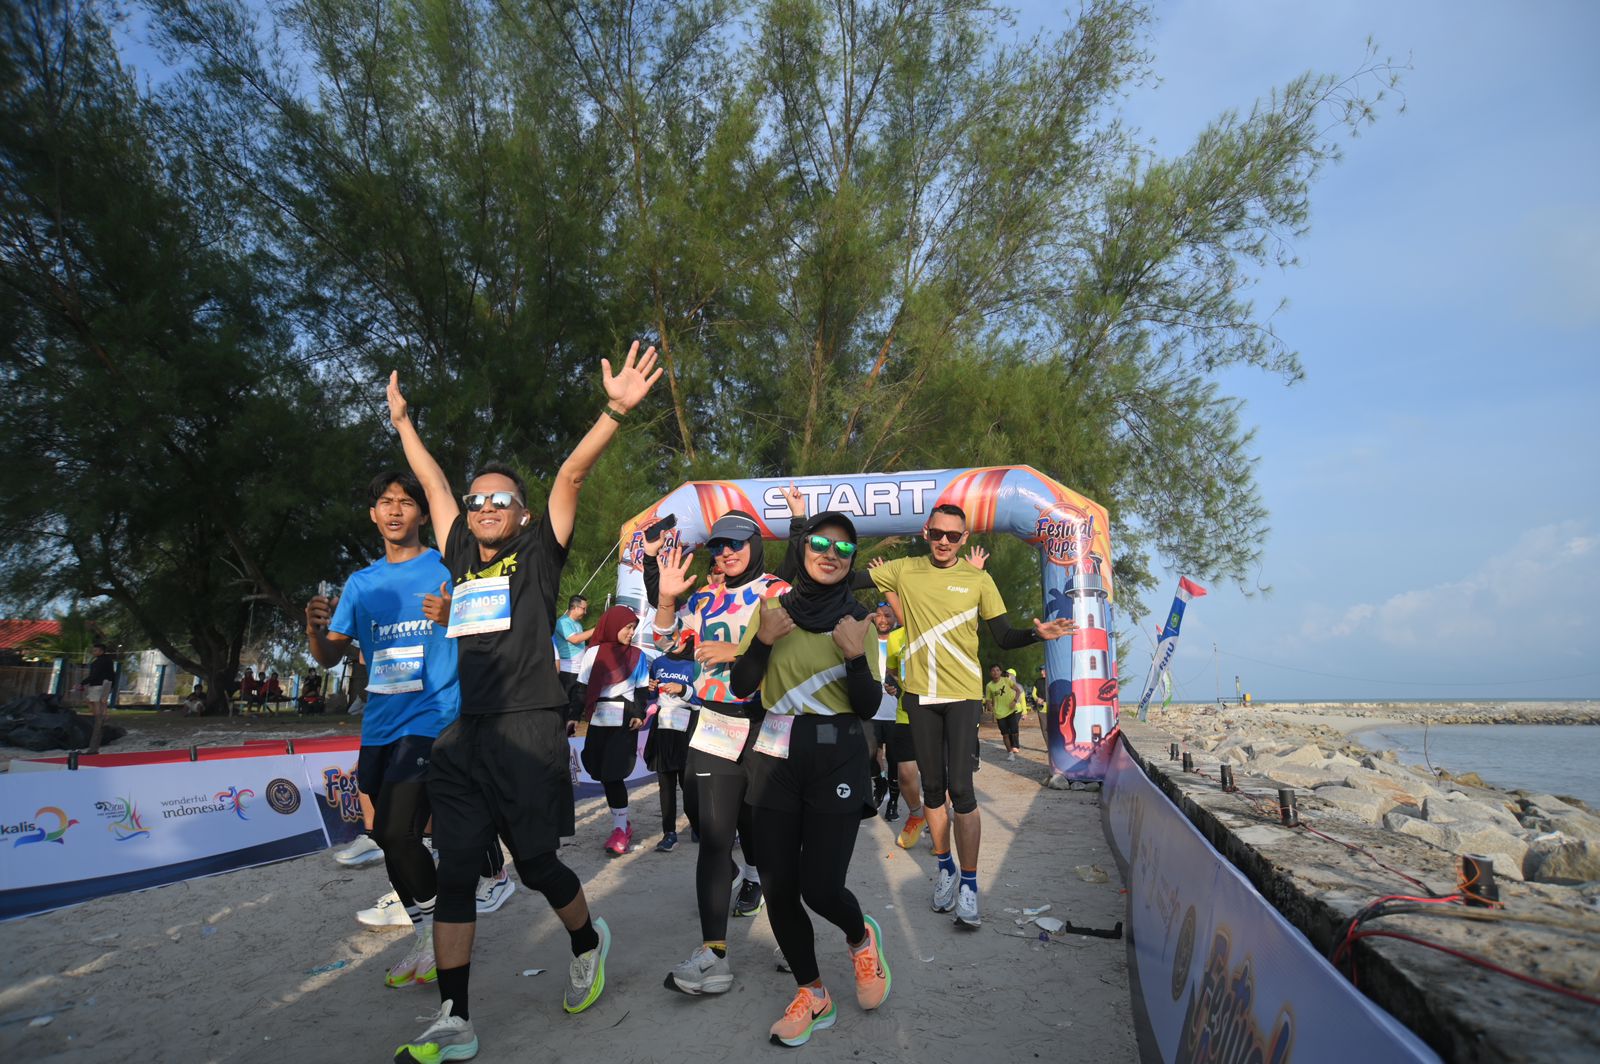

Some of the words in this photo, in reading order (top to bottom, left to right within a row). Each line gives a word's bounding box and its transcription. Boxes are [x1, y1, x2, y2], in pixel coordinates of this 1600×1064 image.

[763, 480, 936, 520] START
[1037, 515, 1094, 538] Festival
[1047, 538, 1081, 558] Rupa
[1159, 642, 1175, 670] RHU
[161, 794, 207, 806] wonderful
[162, 803, 225, 819] indonesia
